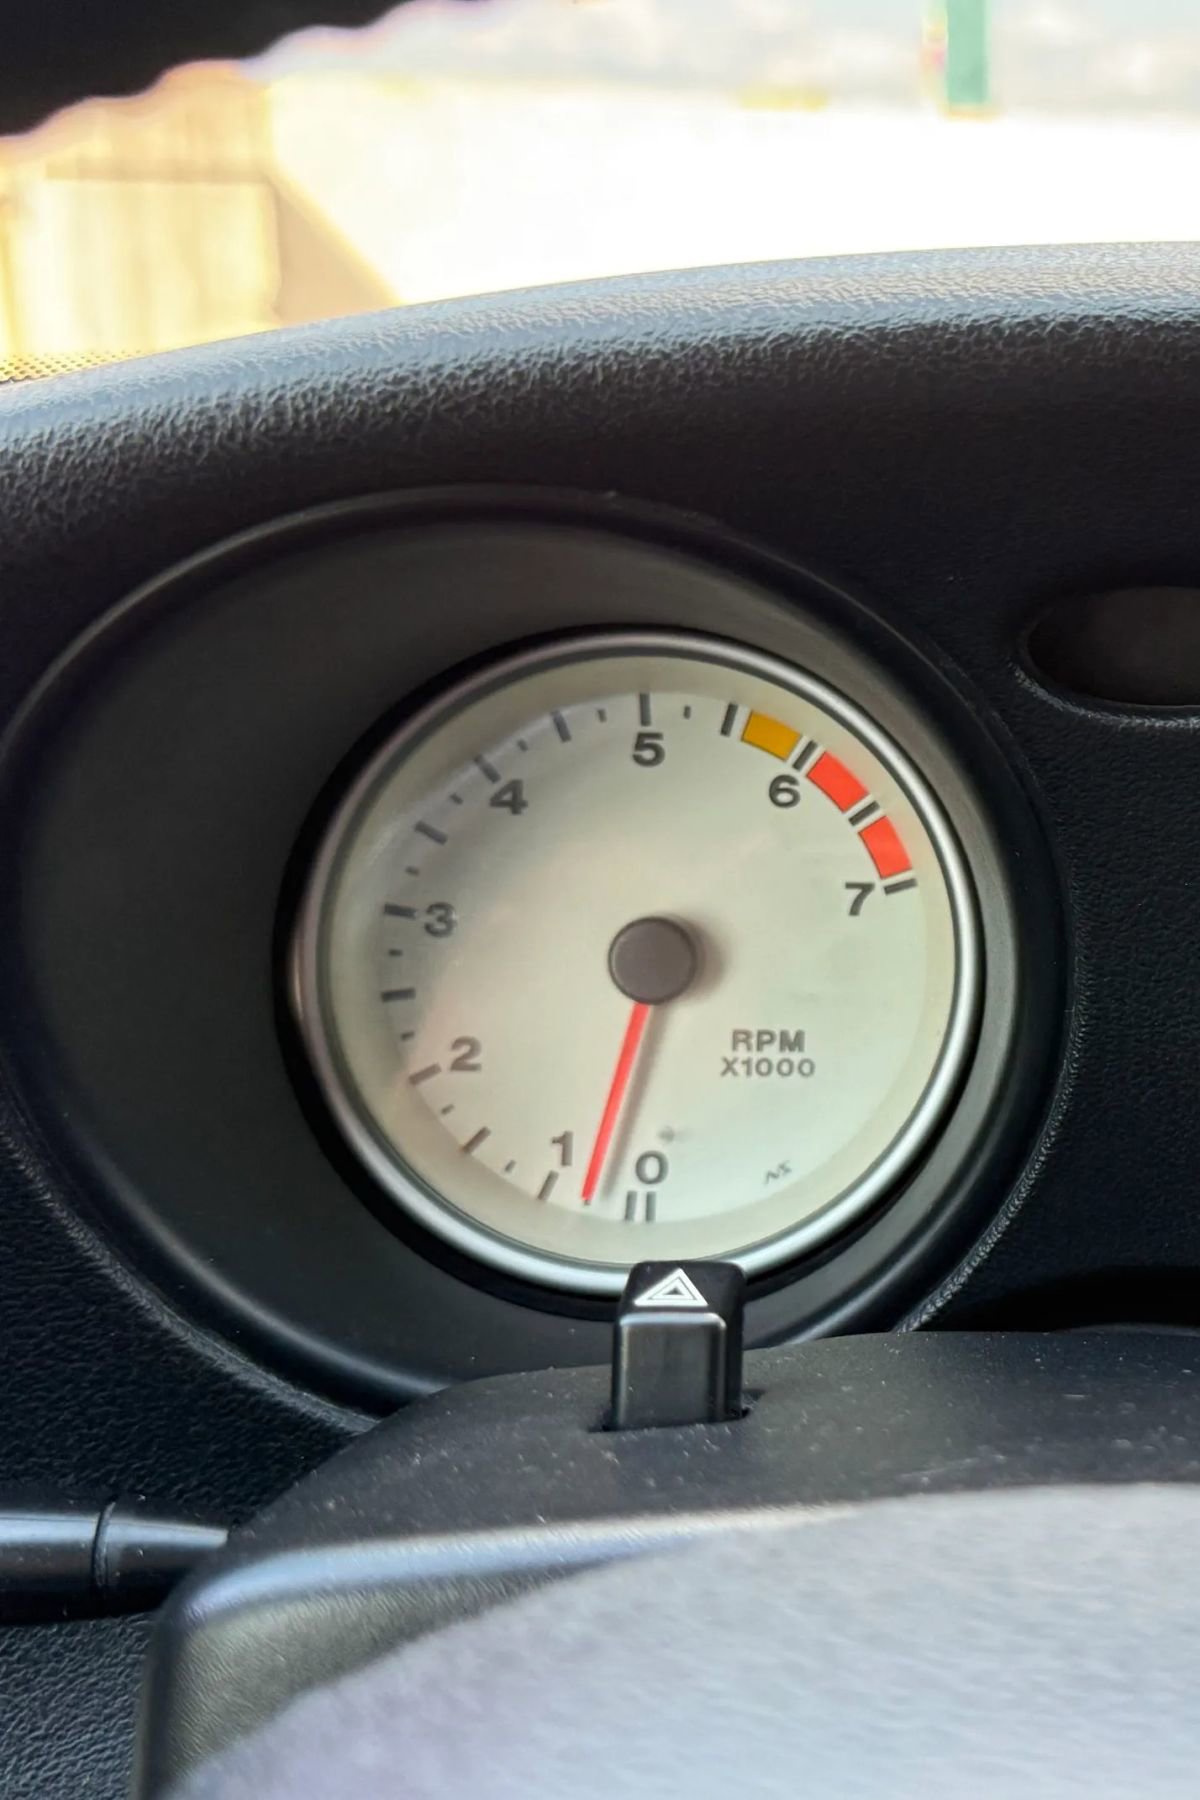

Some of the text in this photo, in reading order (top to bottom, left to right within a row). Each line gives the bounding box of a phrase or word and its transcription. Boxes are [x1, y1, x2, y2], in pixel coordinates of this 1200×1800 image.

[632, 733, 664, 767] 5
[490, 778, 528, 814] 4
[769, 774, 801, 808] 6
[844, 881, 875, 916] 7
[424, 902, 456, 937] 3
[450, 1036, 482, 1071] 2
[731, 1030, 805, 1052] RPM
[720, 1057, 815, 1077] X1000
[551, 1132, 573, 1166] 1
[635, 1150, 669, 1185] 0
